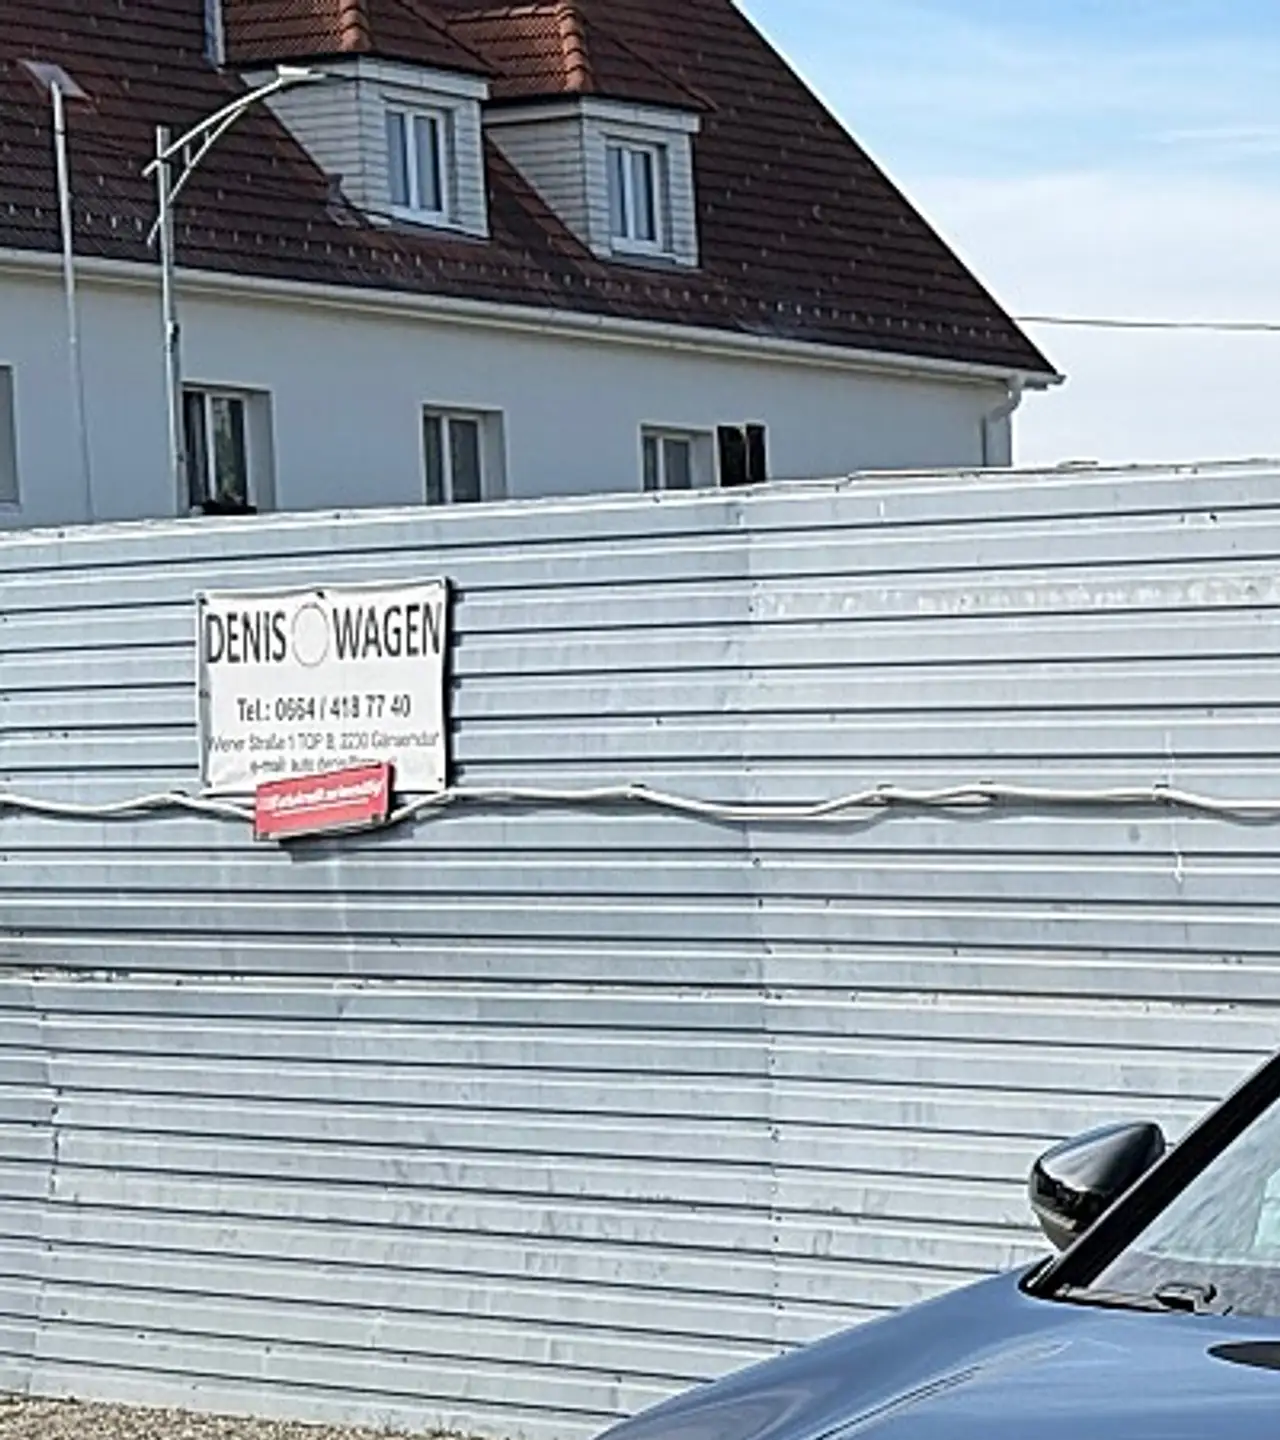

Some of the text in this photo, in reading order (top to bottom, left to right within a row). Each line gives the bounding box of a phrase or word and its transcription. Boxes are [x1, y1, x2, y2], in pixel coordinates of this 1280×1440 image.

[205, 601, 443, 664] DENIS WAGEN
[365, 693, 386, 718] 77
[389, 694, 412, 718] 40
